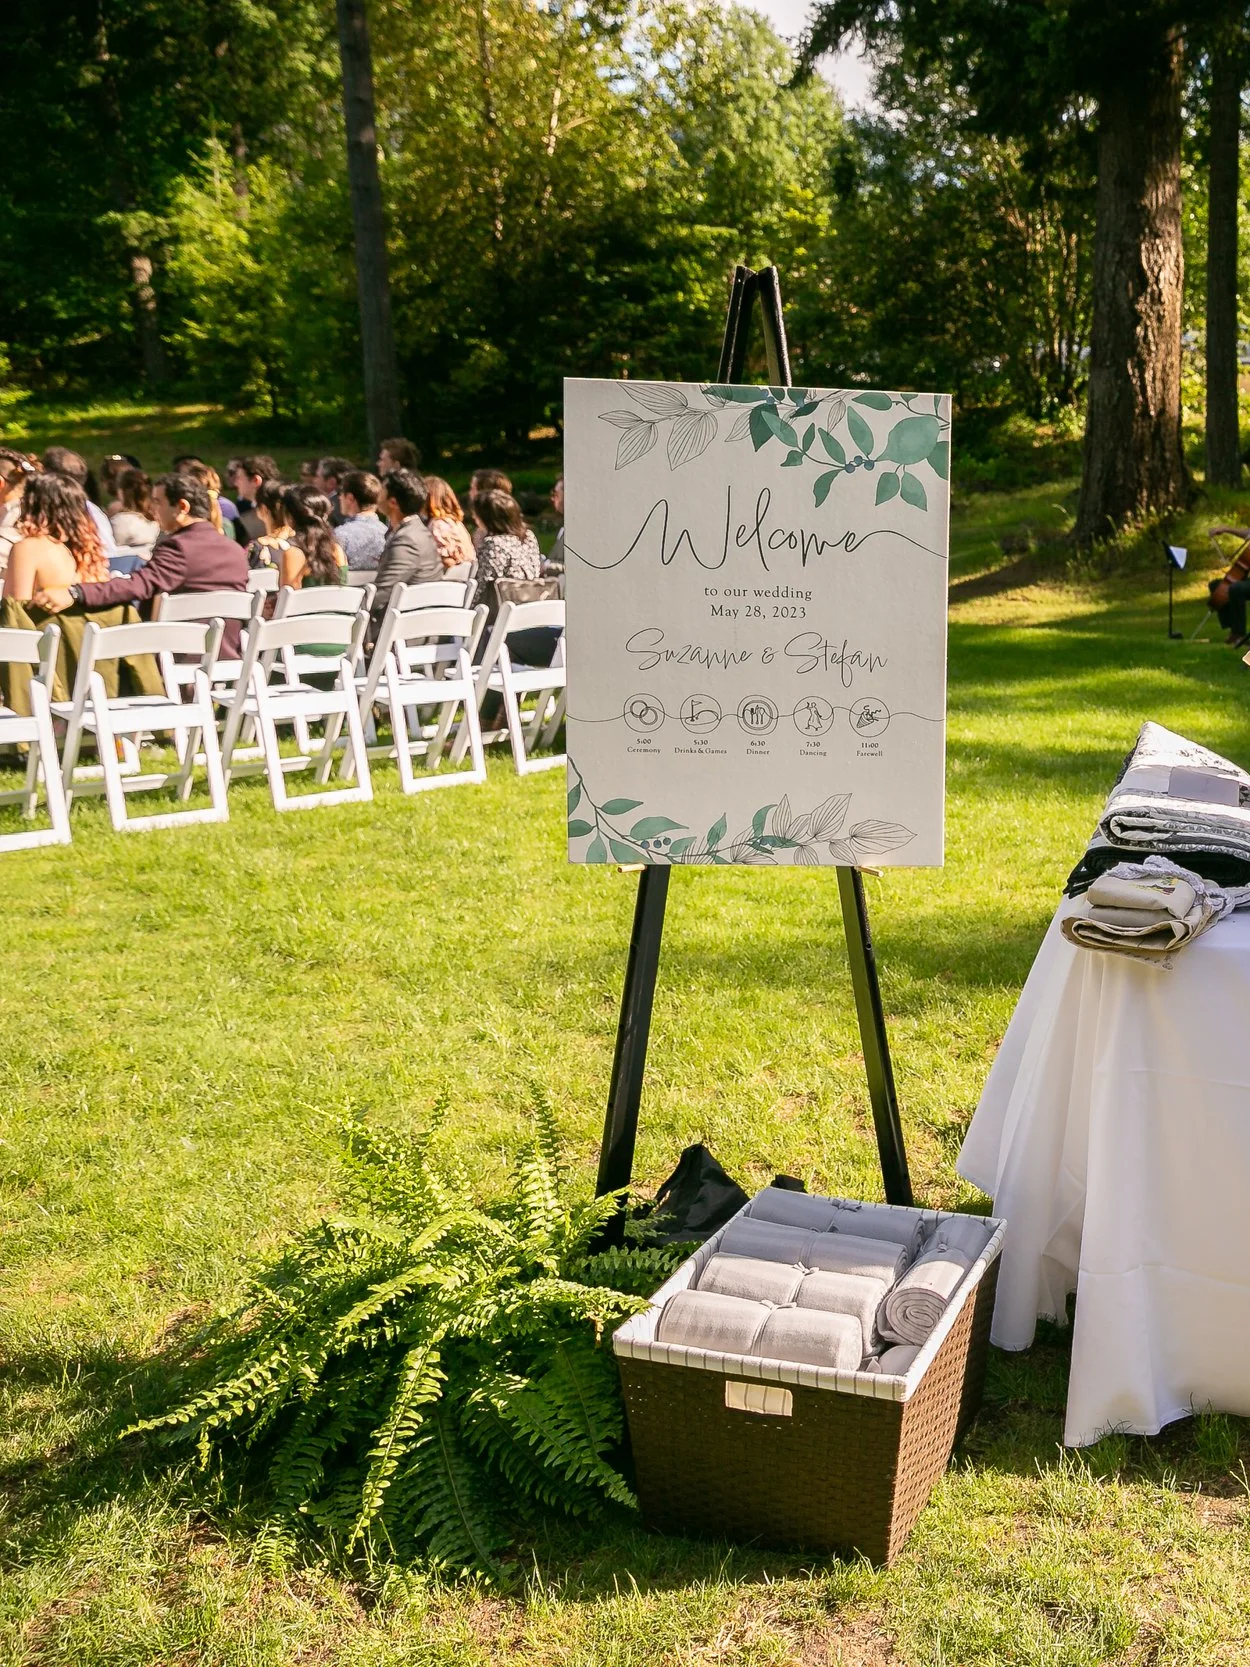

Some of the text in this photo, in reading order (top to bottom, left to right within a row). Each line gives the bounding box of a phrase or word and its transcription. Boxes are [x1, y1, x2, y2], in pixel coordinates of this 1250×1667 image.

[600, 485, 885, 571] Welcome
[704, 585, 812, 601] to our wedding
[710, 604, 806, 619] May 28, 2023
[625, 627, 888, 688] Suzanne & Stefan
[627, 746, 661, 754] Ceremony
[799, 749, 827, 757] Dancing
